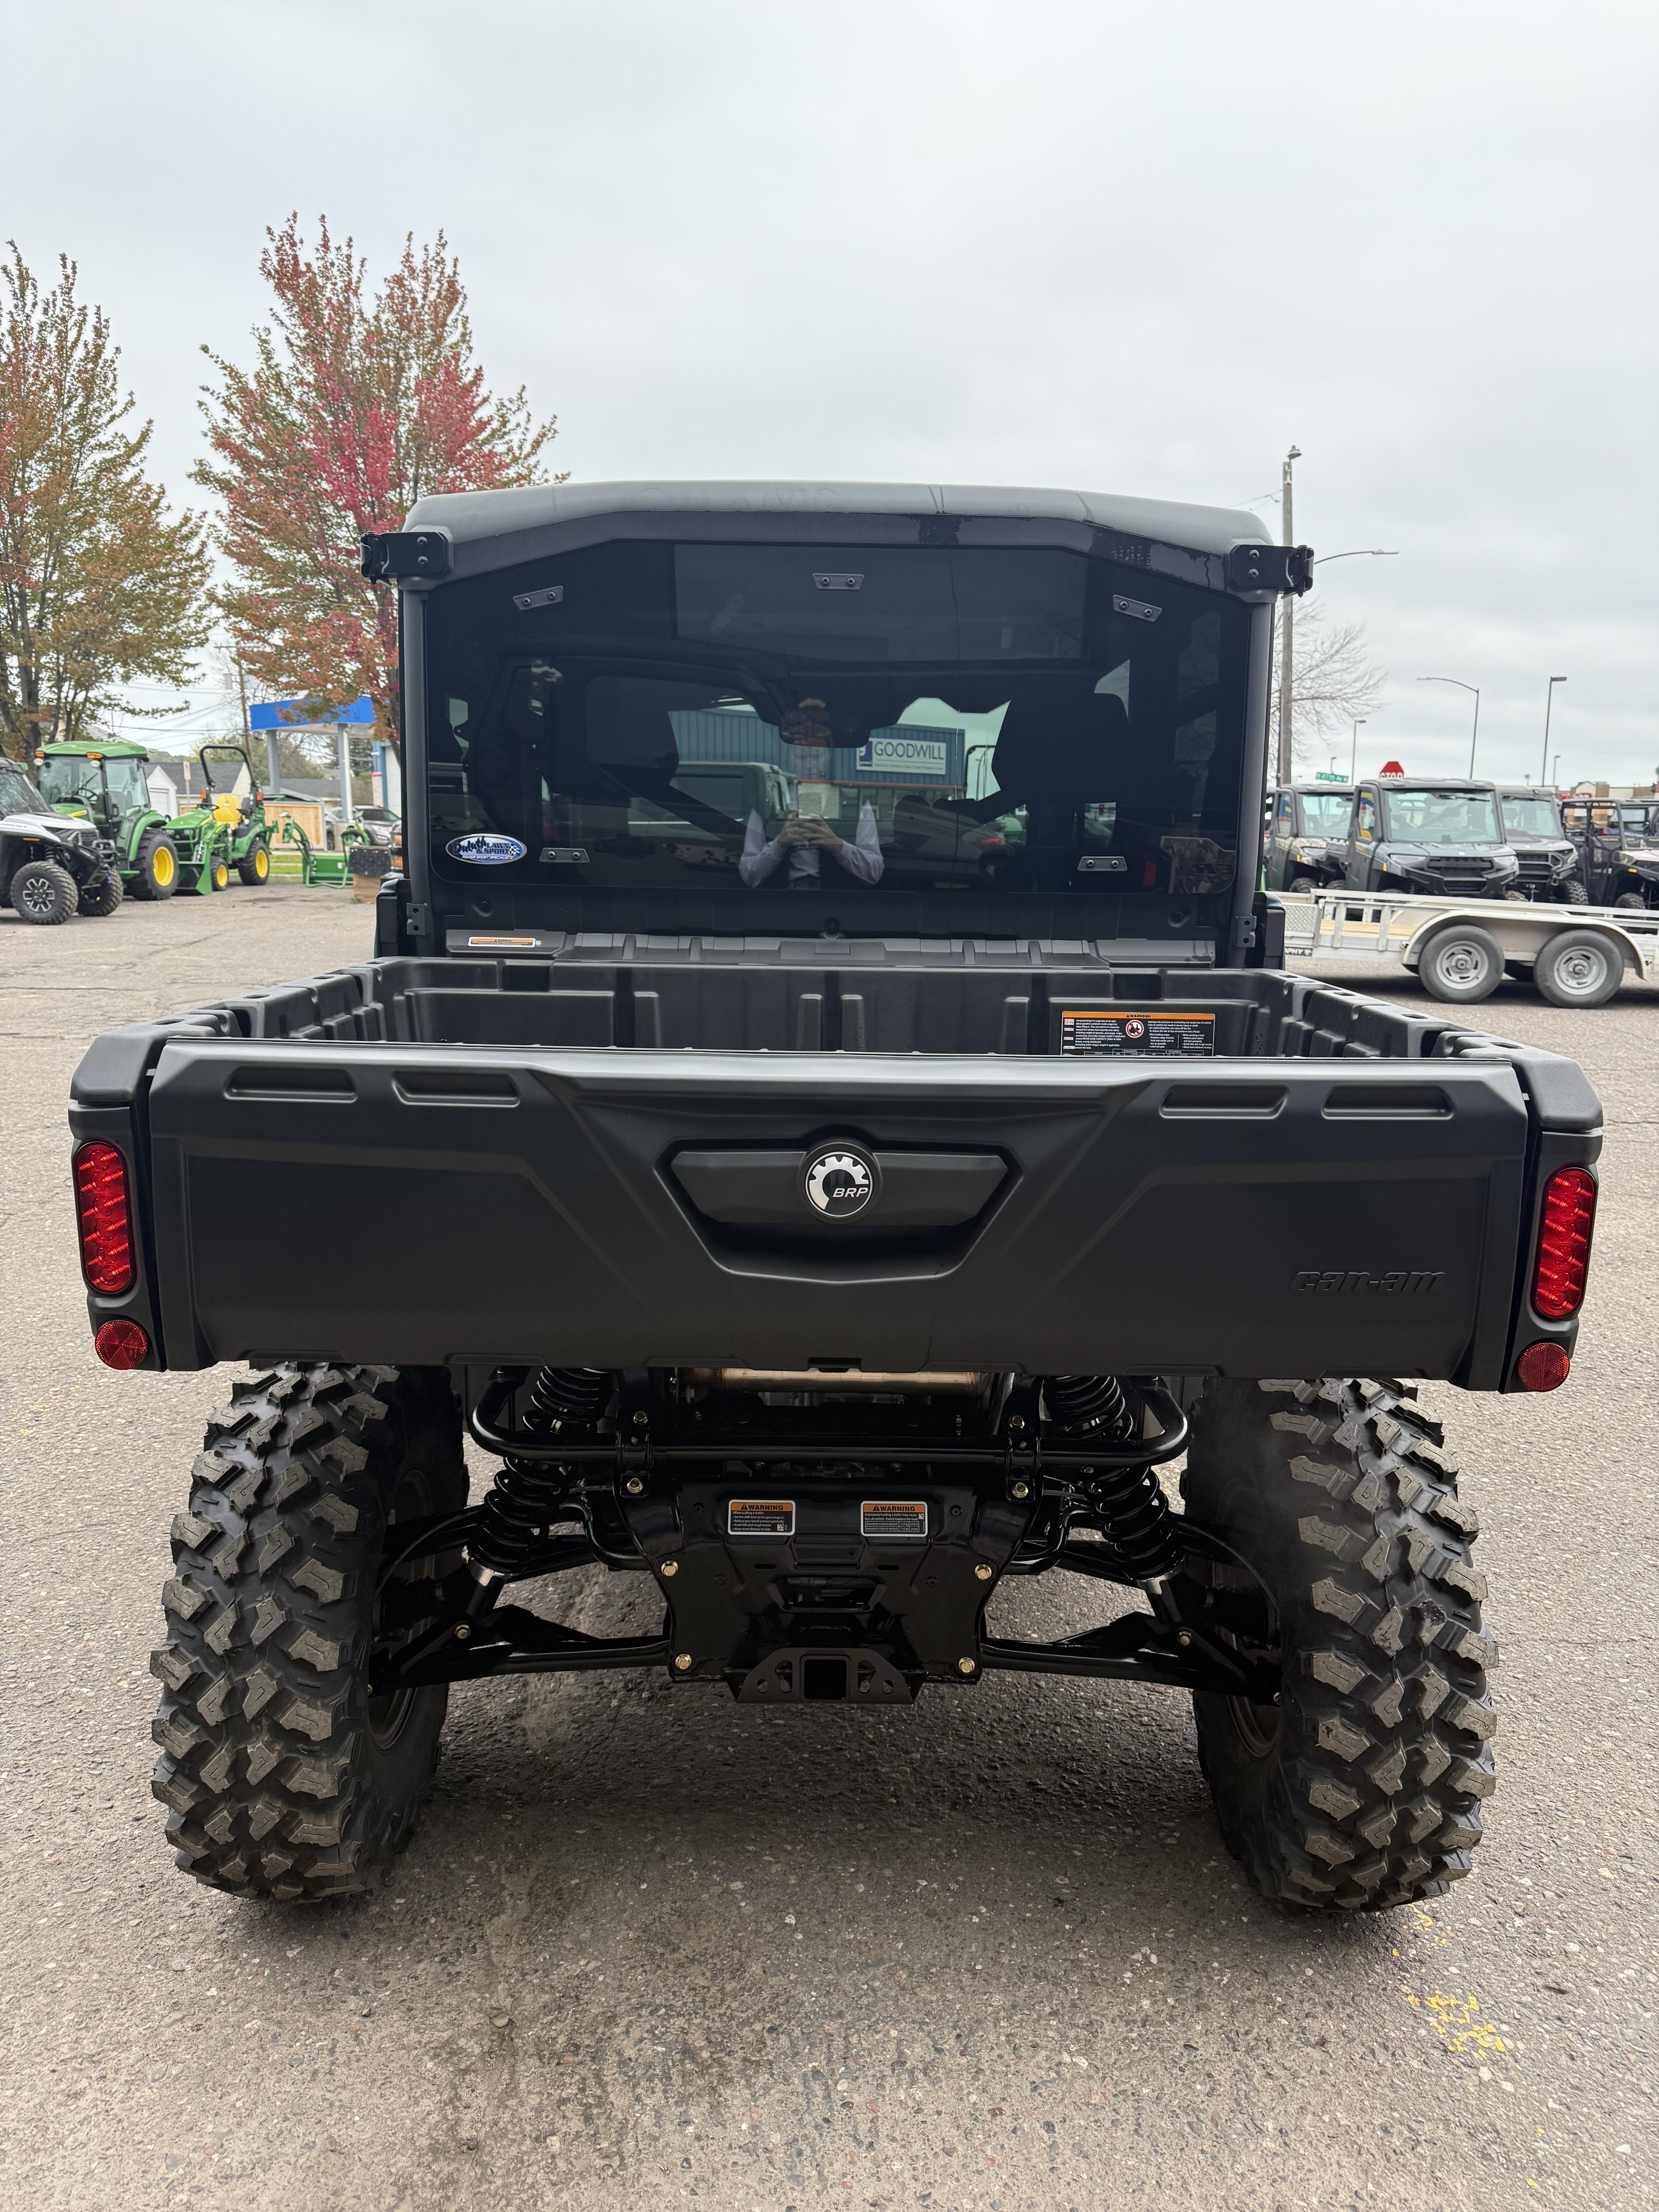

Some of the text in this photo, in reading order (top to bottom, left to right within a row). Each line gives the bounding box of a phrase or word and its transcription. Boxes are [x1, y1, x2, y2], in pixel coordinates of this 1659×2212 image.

[874, 741, 944, 760] GOODWILL
[451, 836, 486, 854] Duluth
[833, 1187, 869, 1197] BRP
